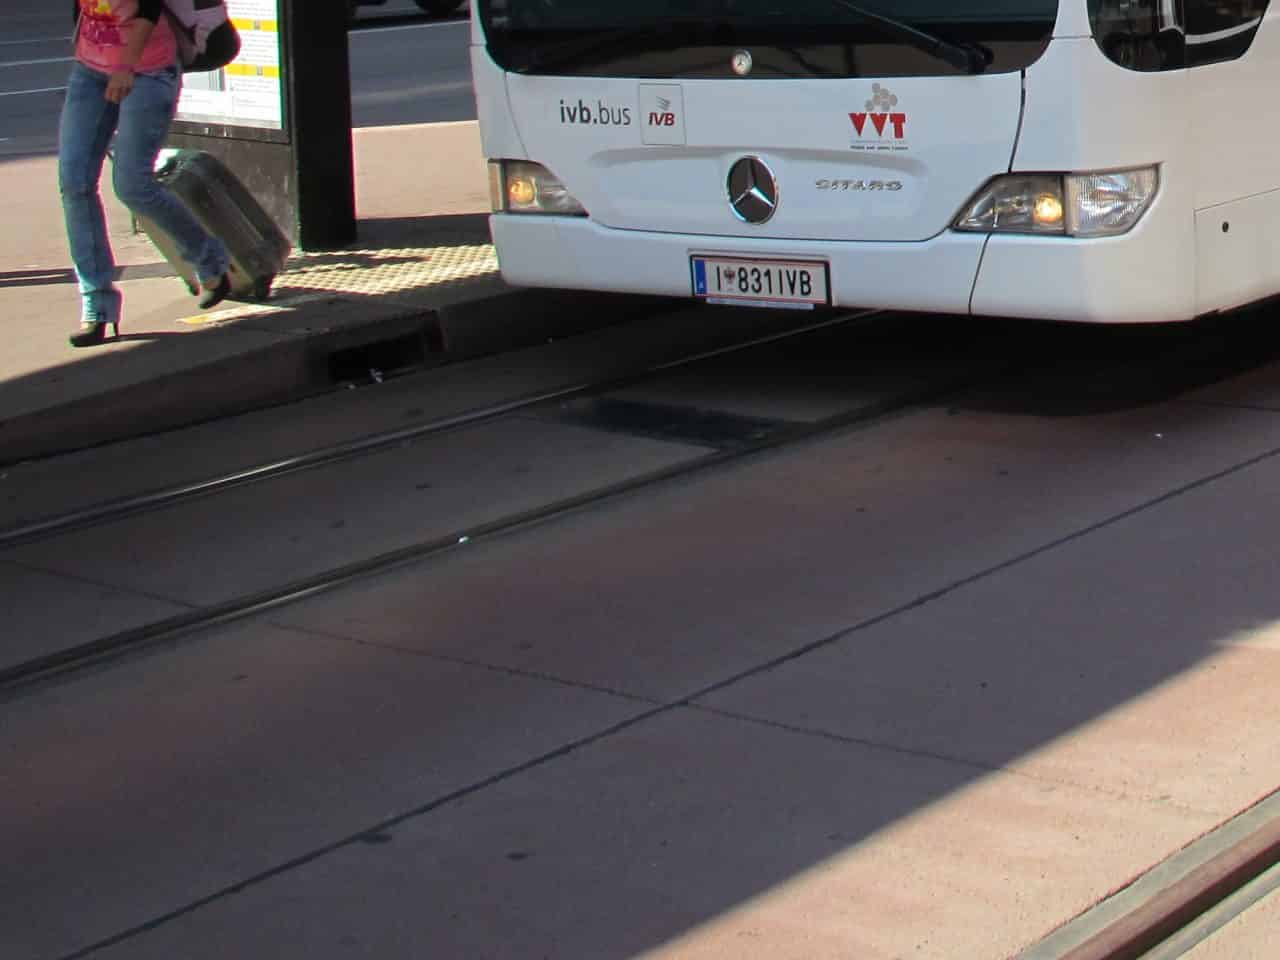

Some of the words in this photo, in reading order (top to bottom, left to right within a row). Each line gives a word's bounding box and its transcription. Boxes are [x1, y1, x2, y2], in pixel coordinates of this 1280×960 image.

[559, 99, 632, 128] ivb.bus
[648, 112, 675, 128] IVB
[849, 112, 908, 139] VVT
